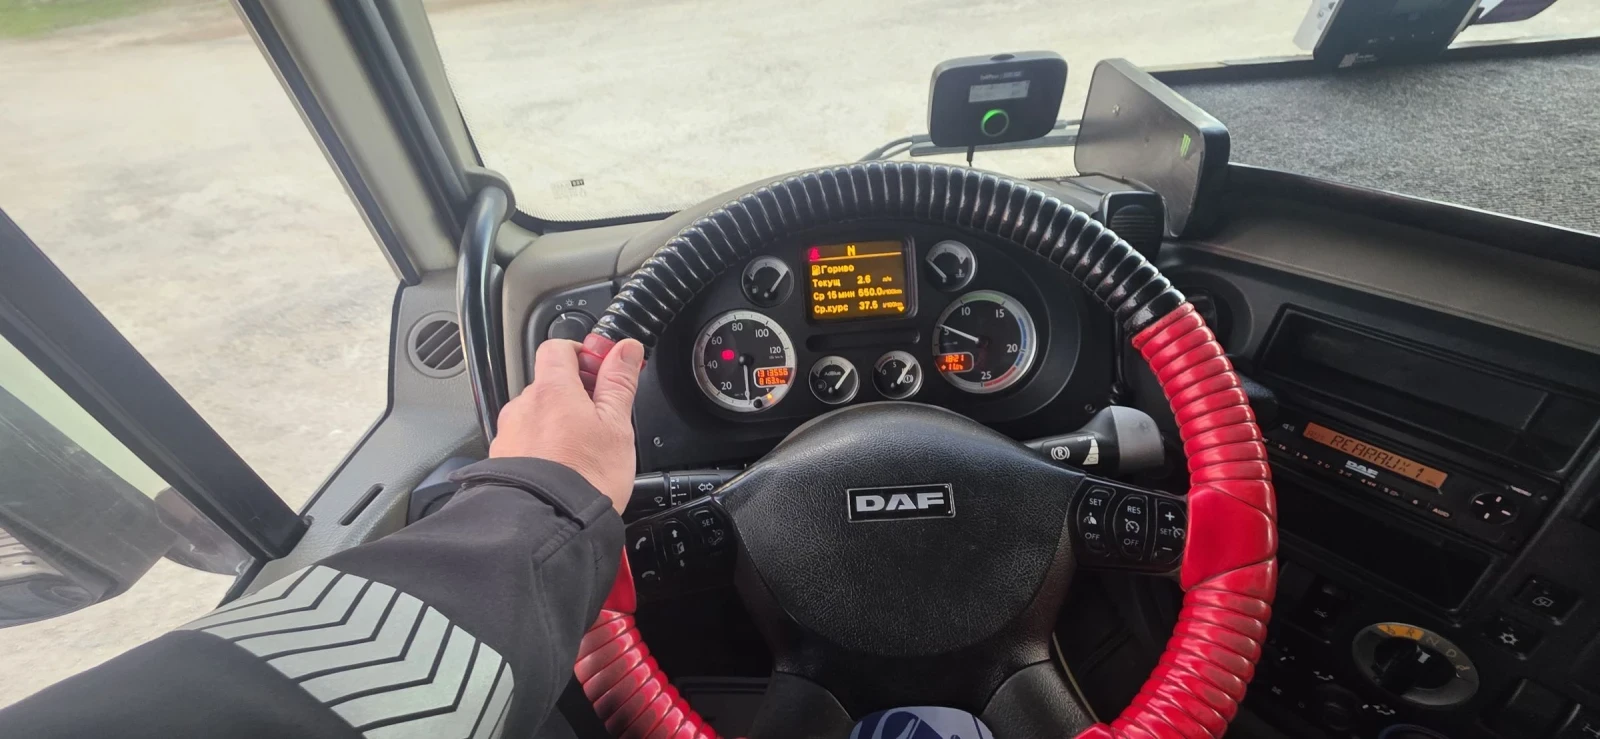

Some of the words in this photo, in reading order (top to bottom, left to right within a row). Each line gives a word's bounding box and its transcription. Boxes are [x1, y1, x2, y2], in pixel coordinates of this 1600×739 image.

[847, 245, 856, 256] N
[821, 264, 855, 274] Гориво
[812, 278, 841, 288] Текущ
[813, 291, 825, 301] Ср
[827, 290, 838, 300] 15
[838, 290, 855, 299] мин
[961, 306, 971, 316] 10
[995, 308, 1005, 318] 15
[731, 322, 743, 331] 80
[755, 328, 769, 338] 100
[711, 336, 722, 345] 60
[769, 346, 781, 354] 120
[1006, 343, 1018, 353] 20
[707, 360, 718, 369] 40
[981, 371, 992, 379] 25
[721, 381, 732, 390] 20
[1346, 460, 1379, 476] DAF
[855, 492, 945, 512] DAF
[1089, 498, 1102, 507] SET
[1127, 505, 1141, 515] RES
[702, 518, 714, 527] SET
[1084, 532, 1100, 541] OFF
[1160, 528, 1172, 536] SET
[1123, 538, 1139, 547] OFF
